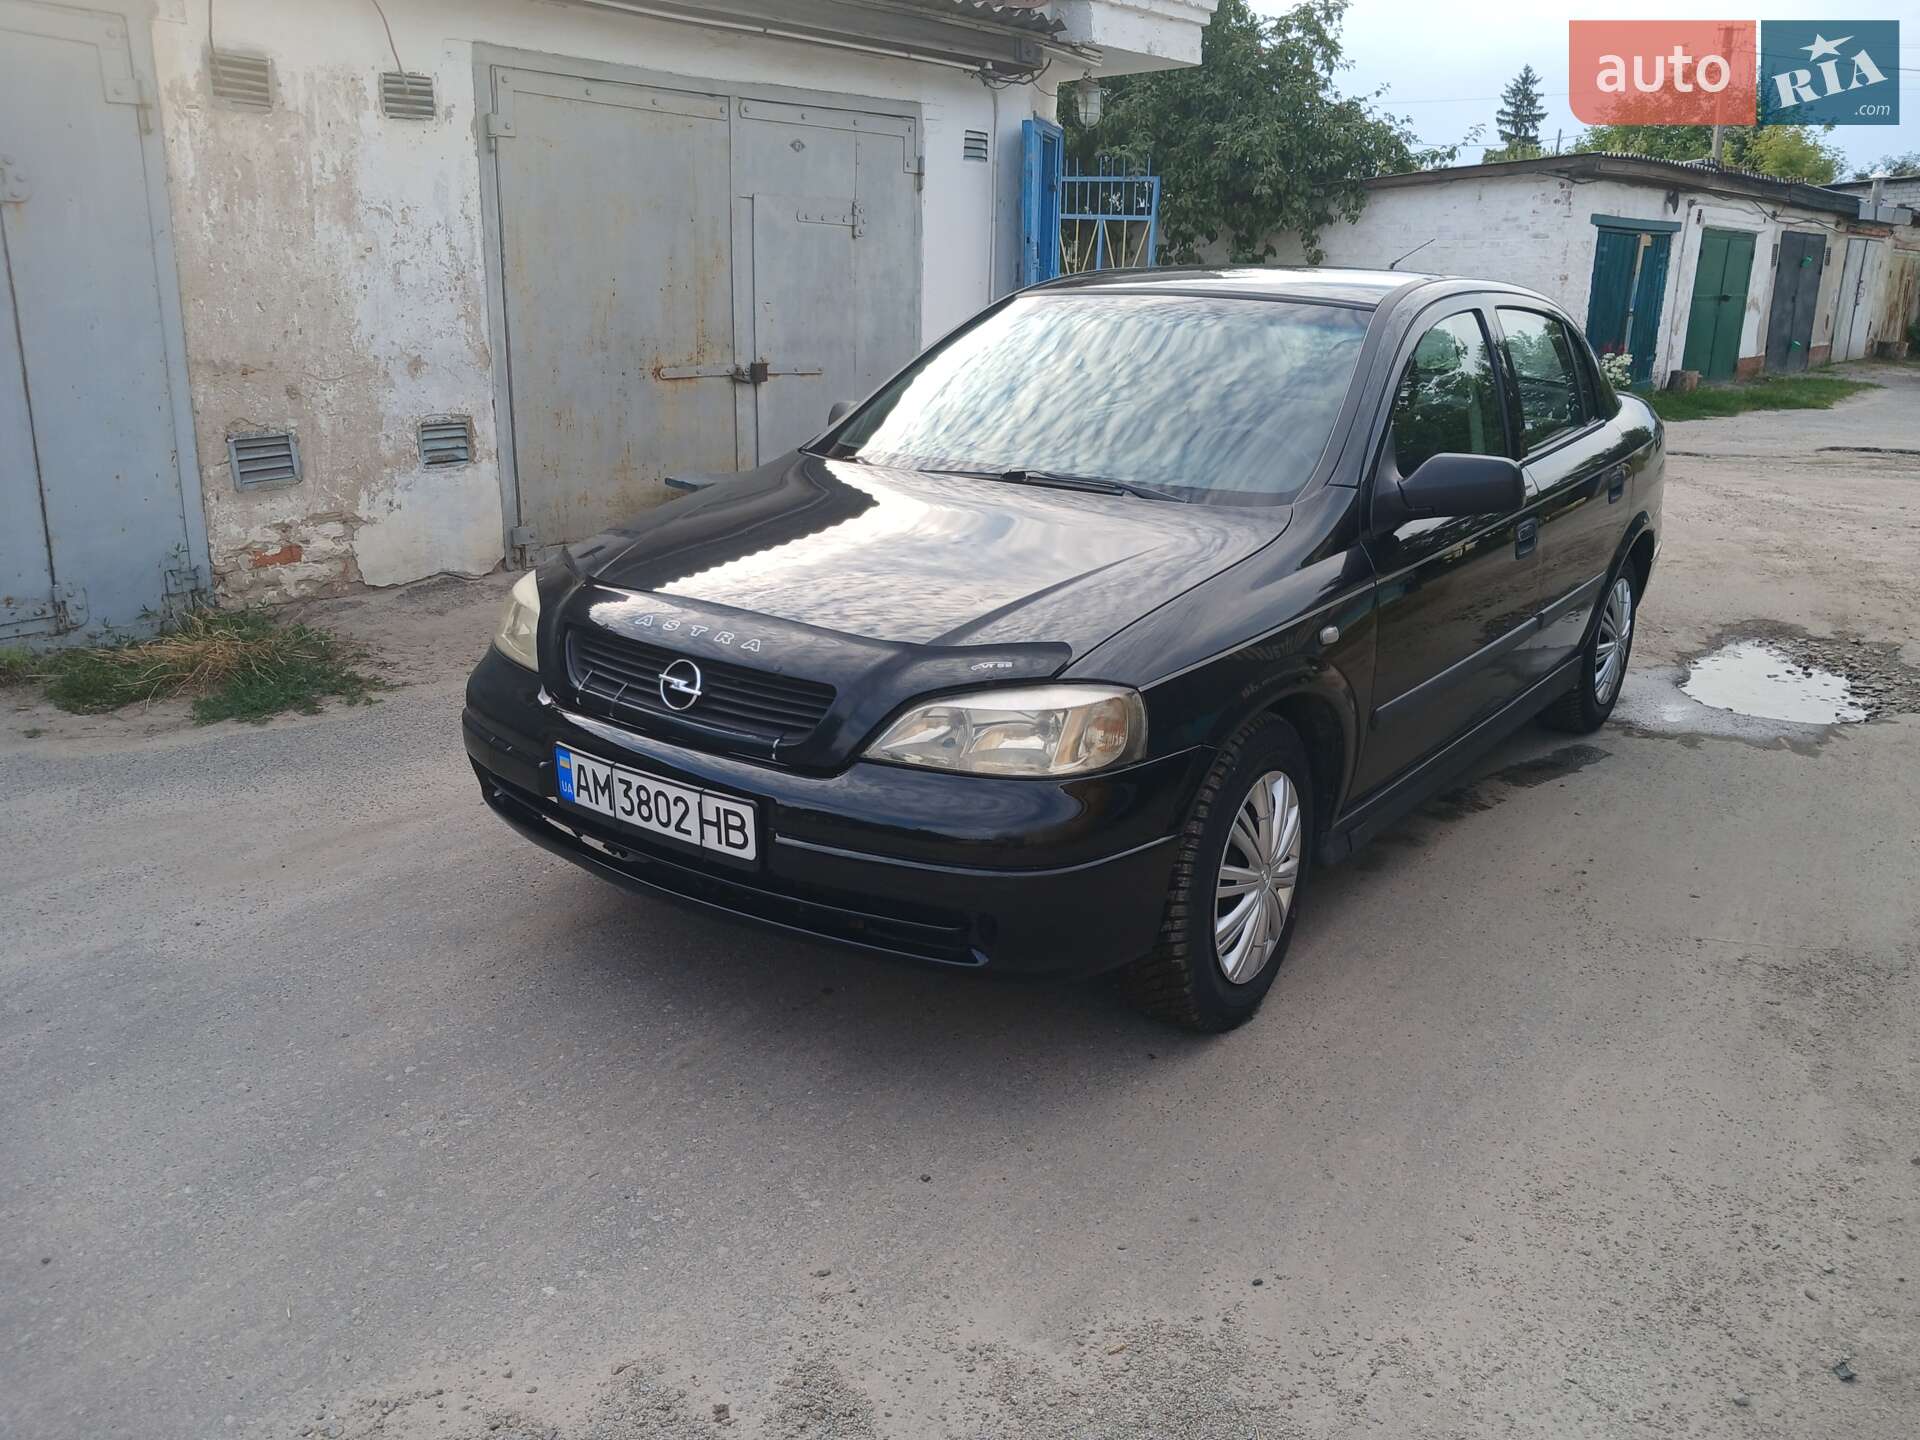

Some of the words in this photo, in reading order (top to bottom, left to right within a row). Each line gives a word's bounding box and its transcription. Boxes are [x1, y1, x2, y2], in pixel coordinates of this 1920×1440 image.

[635, 615, 761, 653] ASTRA
[561, 780, 573, 794] UA
[576, 763, 613, 811] AM
[617, 778, 692, 836] 3802
[697, 801, 749, 850] HB
